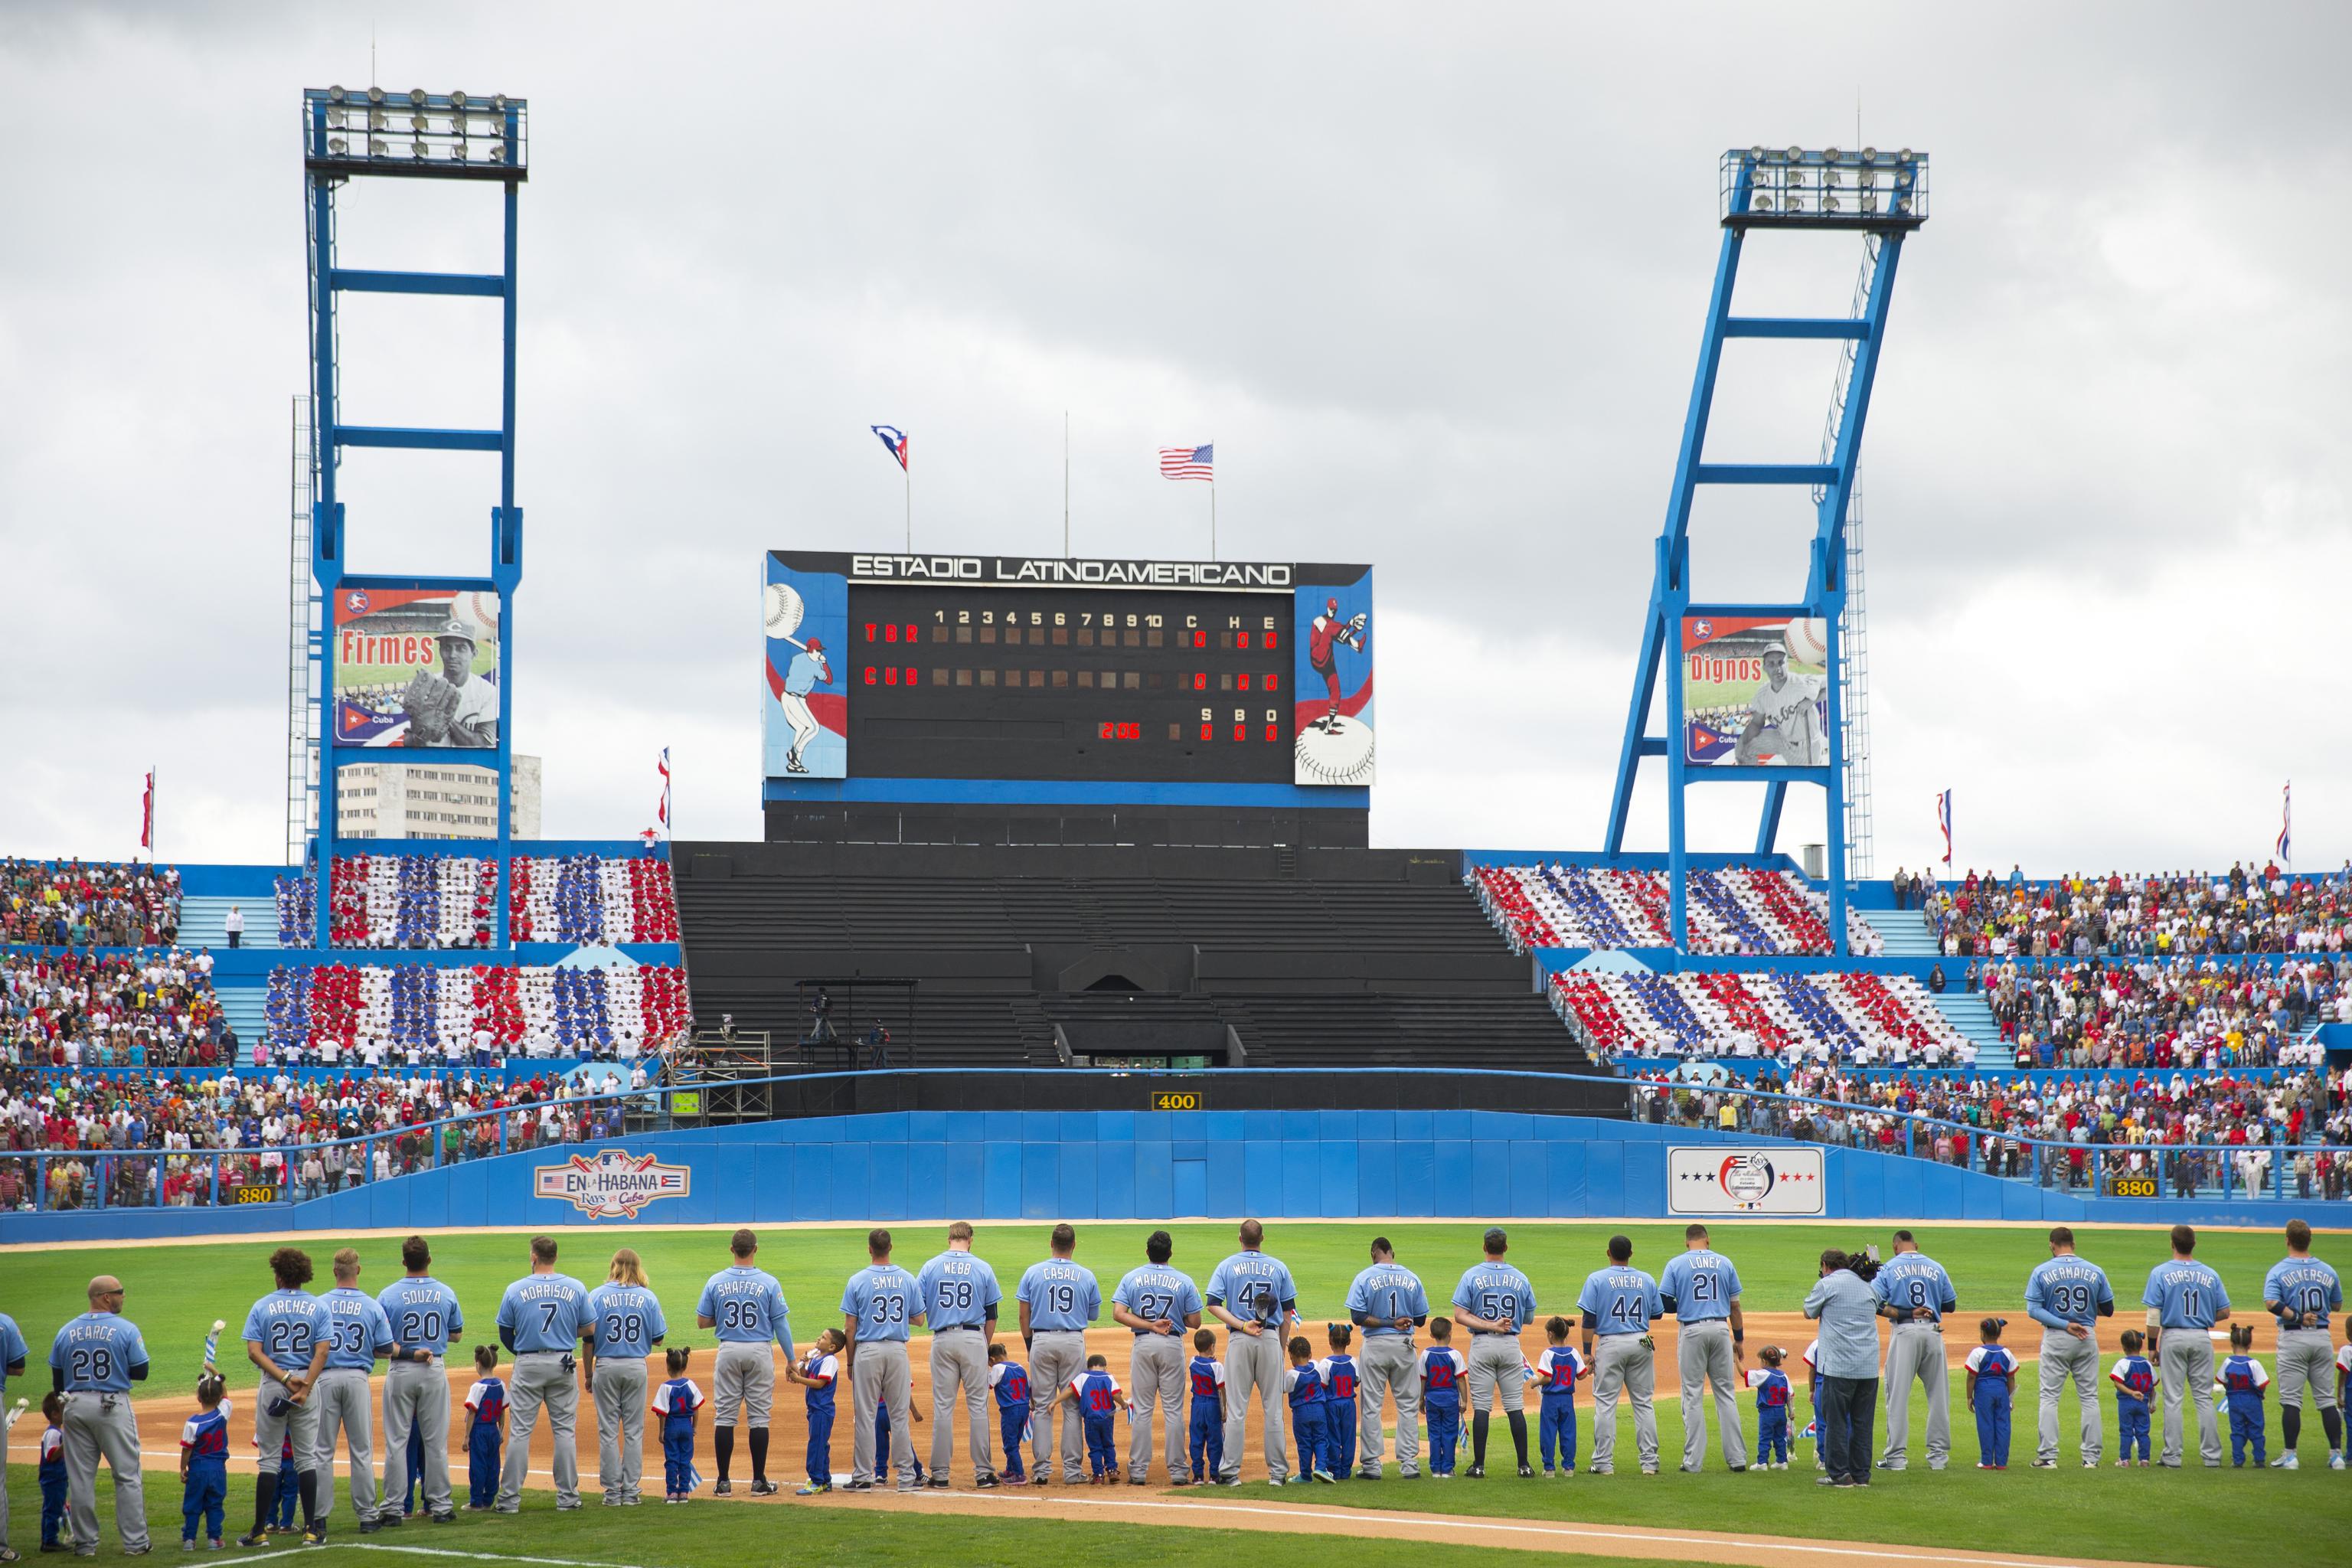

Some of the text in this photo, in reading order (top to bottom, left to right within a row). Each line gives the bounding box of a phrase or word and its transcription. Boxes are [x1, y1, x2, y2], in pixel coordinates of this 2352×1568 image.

[852, 556, 1290, 586] ESTADIO LATINOAMERICANO
[936, 611, 1274, 629] 1 2 3 4 5 6 7 8 9 10 C H E
[342, 630, 434, 665] Firmes
[1194, 631, 1206, 648] 0
[1237, 632, 1249, 648] 0
[1266, 632, 1277, 648] 0
[1690, 654, 1761, 684] Dignos
[1194, 674, 1206, 690] 0
[1238, 674, 1250, 691] 0
[1266, 675, 1277, 691] 0
[372, 716, 394, 724] Cuba
[1201, 708, 1212, 721] S
[1234, 709, 1245, 721] B
[1200, 724, 1212, 740] 0
[1234, 725, 1245, 741] 0
[1266, 725, 1277, 741] 0
[1718, 735, 1737, 743] Cuba
[1158, 1095, 1194, 1109] 400
[567, 1174, 586, 1192] EN
[598, 1174, 658, 1191] HABANA
[2117, 1181, 2154, 1196] 380
[238, 1188, 272, 1203] 380
[619, 1192, 645, 1204] Cuba
[943, 1263, 971, 1276] WEBB
[1233, 1262, 1275, 1277] WHITLEY
[1688, 1256, 1721, 1269] LONEY
[1043, 1267, 1082, 1282] CASALI
[1609, 1276, 1643, 1289] RIVERA
[1893, 1264, 1940, 1282] JENNINGS
[2042, 1267, 2098, 1285] KIERMAIER
[2164, 1270, 2215, 1289] FORSYTHE
[2282, 1269, 2334, 1289] DICKERSON
[717, 1281, 764, 1298] SHAFFER
[871, 1276, 903, 1290] SMYLY
[1135, 1274, 1182, 1292] MAHTOOK
[1369, 1274, 1416, 1292] BECKHAM
[1475, 1274, 1523, 1292] BELLATTI
[1693, 1272, 1718, 1302] 21
[401, 1289, 442, 1305] SOUZA
[519, 1284, 576, 1303] MORRISON
[603, 1293, 645, 1309] MOTTER
[938, 1281, 972, 1310] 58
[1048, 1284, 1073, 1314] 19
[1909, 1280, 1926, 1307] 8
[2053, 1285, 2089, 1314] 39
[2183, 1288, 2200, 1317] 11
[2298, 1286, 2324, 1314] 10
[268, 1299, 316, 1317] ARCHER
[332, 1300, 362, 1316] COBB
[871, 1294, 904, 1324] 33
[1140, 1292, 1174, 1321] 27
[1389, 1290, 1396, 1318] 1
[1481, 1293, 1517, 1321] 59
[1611, 1295, 1642, 1323] 44
[539, 1302, 557, 1334] 7
[724, 1300, 758, 1330] 36
[69, 1325, 117, 1344] PEARCE
[402, 1311, 441, 1342] 20
[606, 1313, 642, 1344] 38
[271, 1321, 310, 1354] 22
[329, 1320, 365, 1354] 53
[71, 1348, 112, 1382] 28
[1192, 1374, 1213, 1396] 33
[1429, 1365, 1453, 1388] 22
[1009, 1378, 1027, 1400] 37
[1334, 1376, 1352, 1397] 10
[1089, 1389, 1111, 1411] 30
